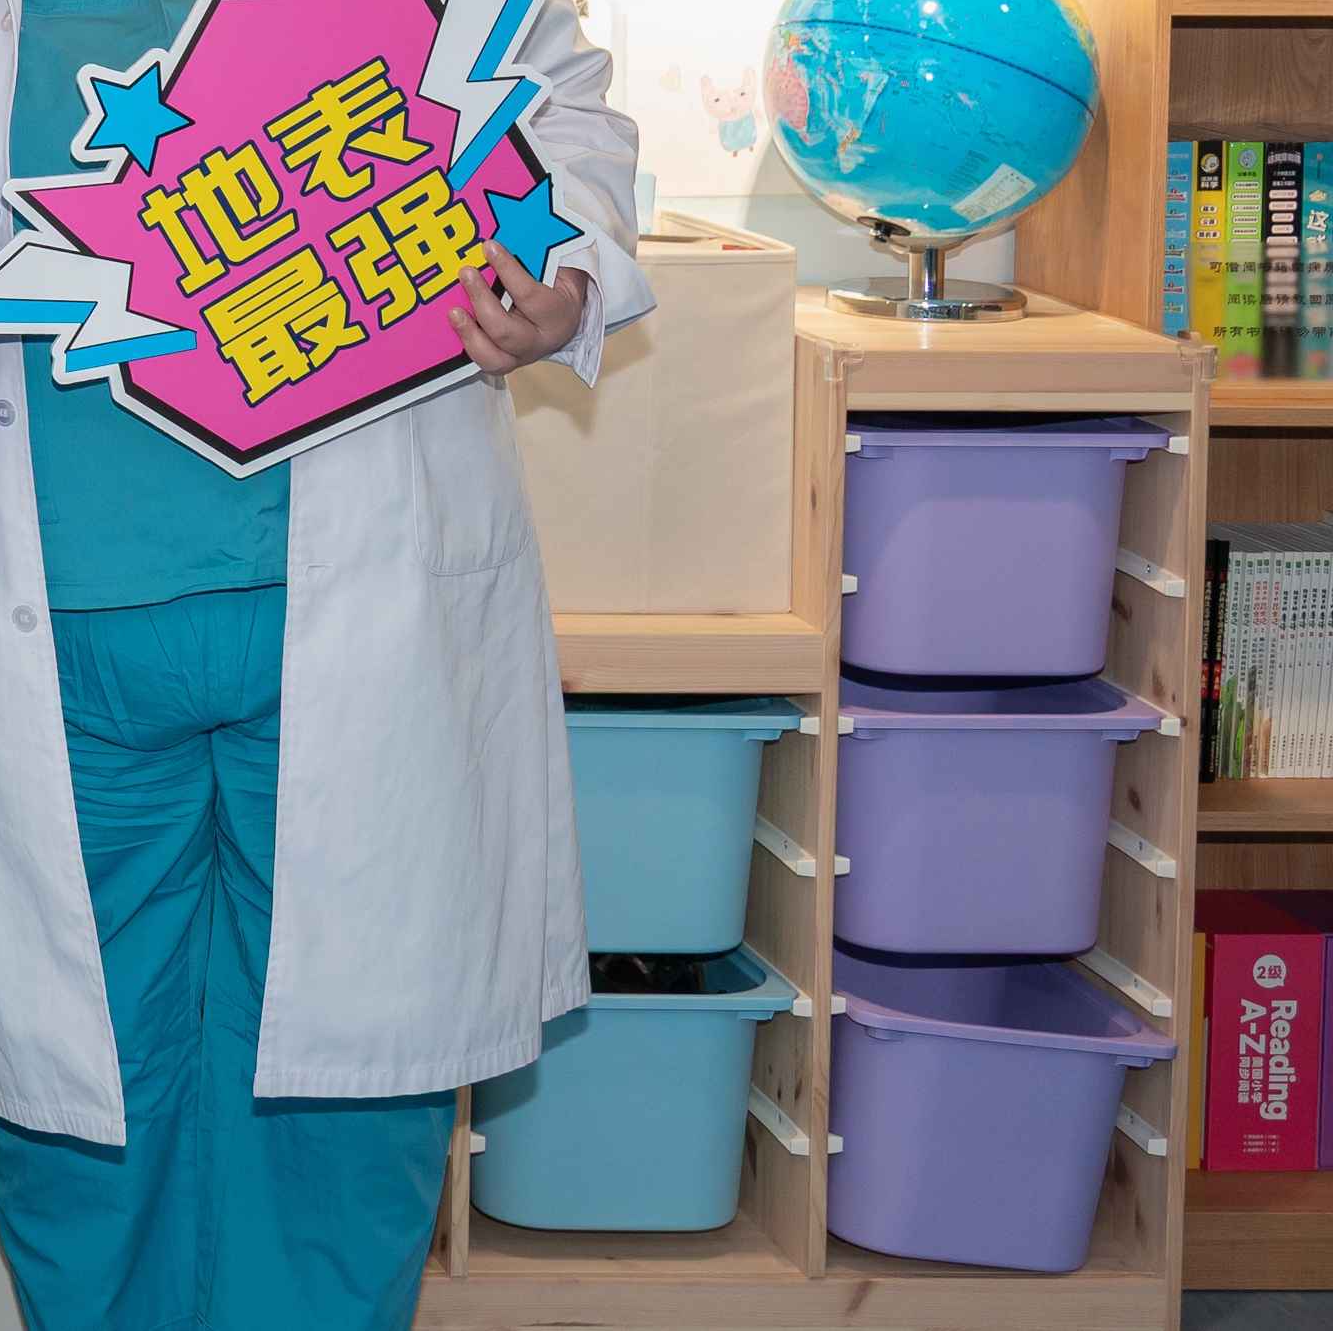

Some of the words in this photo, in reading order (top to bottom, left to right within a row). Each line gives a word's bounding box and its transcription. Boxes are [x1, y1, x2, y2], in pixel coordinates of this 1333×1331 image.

[141, 56, 434, 297] 地表
[199, 166, 488, 407] 最强
[1238, 998, 1268, 1055] A-Z
[1256, 965, 1283, 979] 2级
[1259, 999, 1298, 1121] Reading
